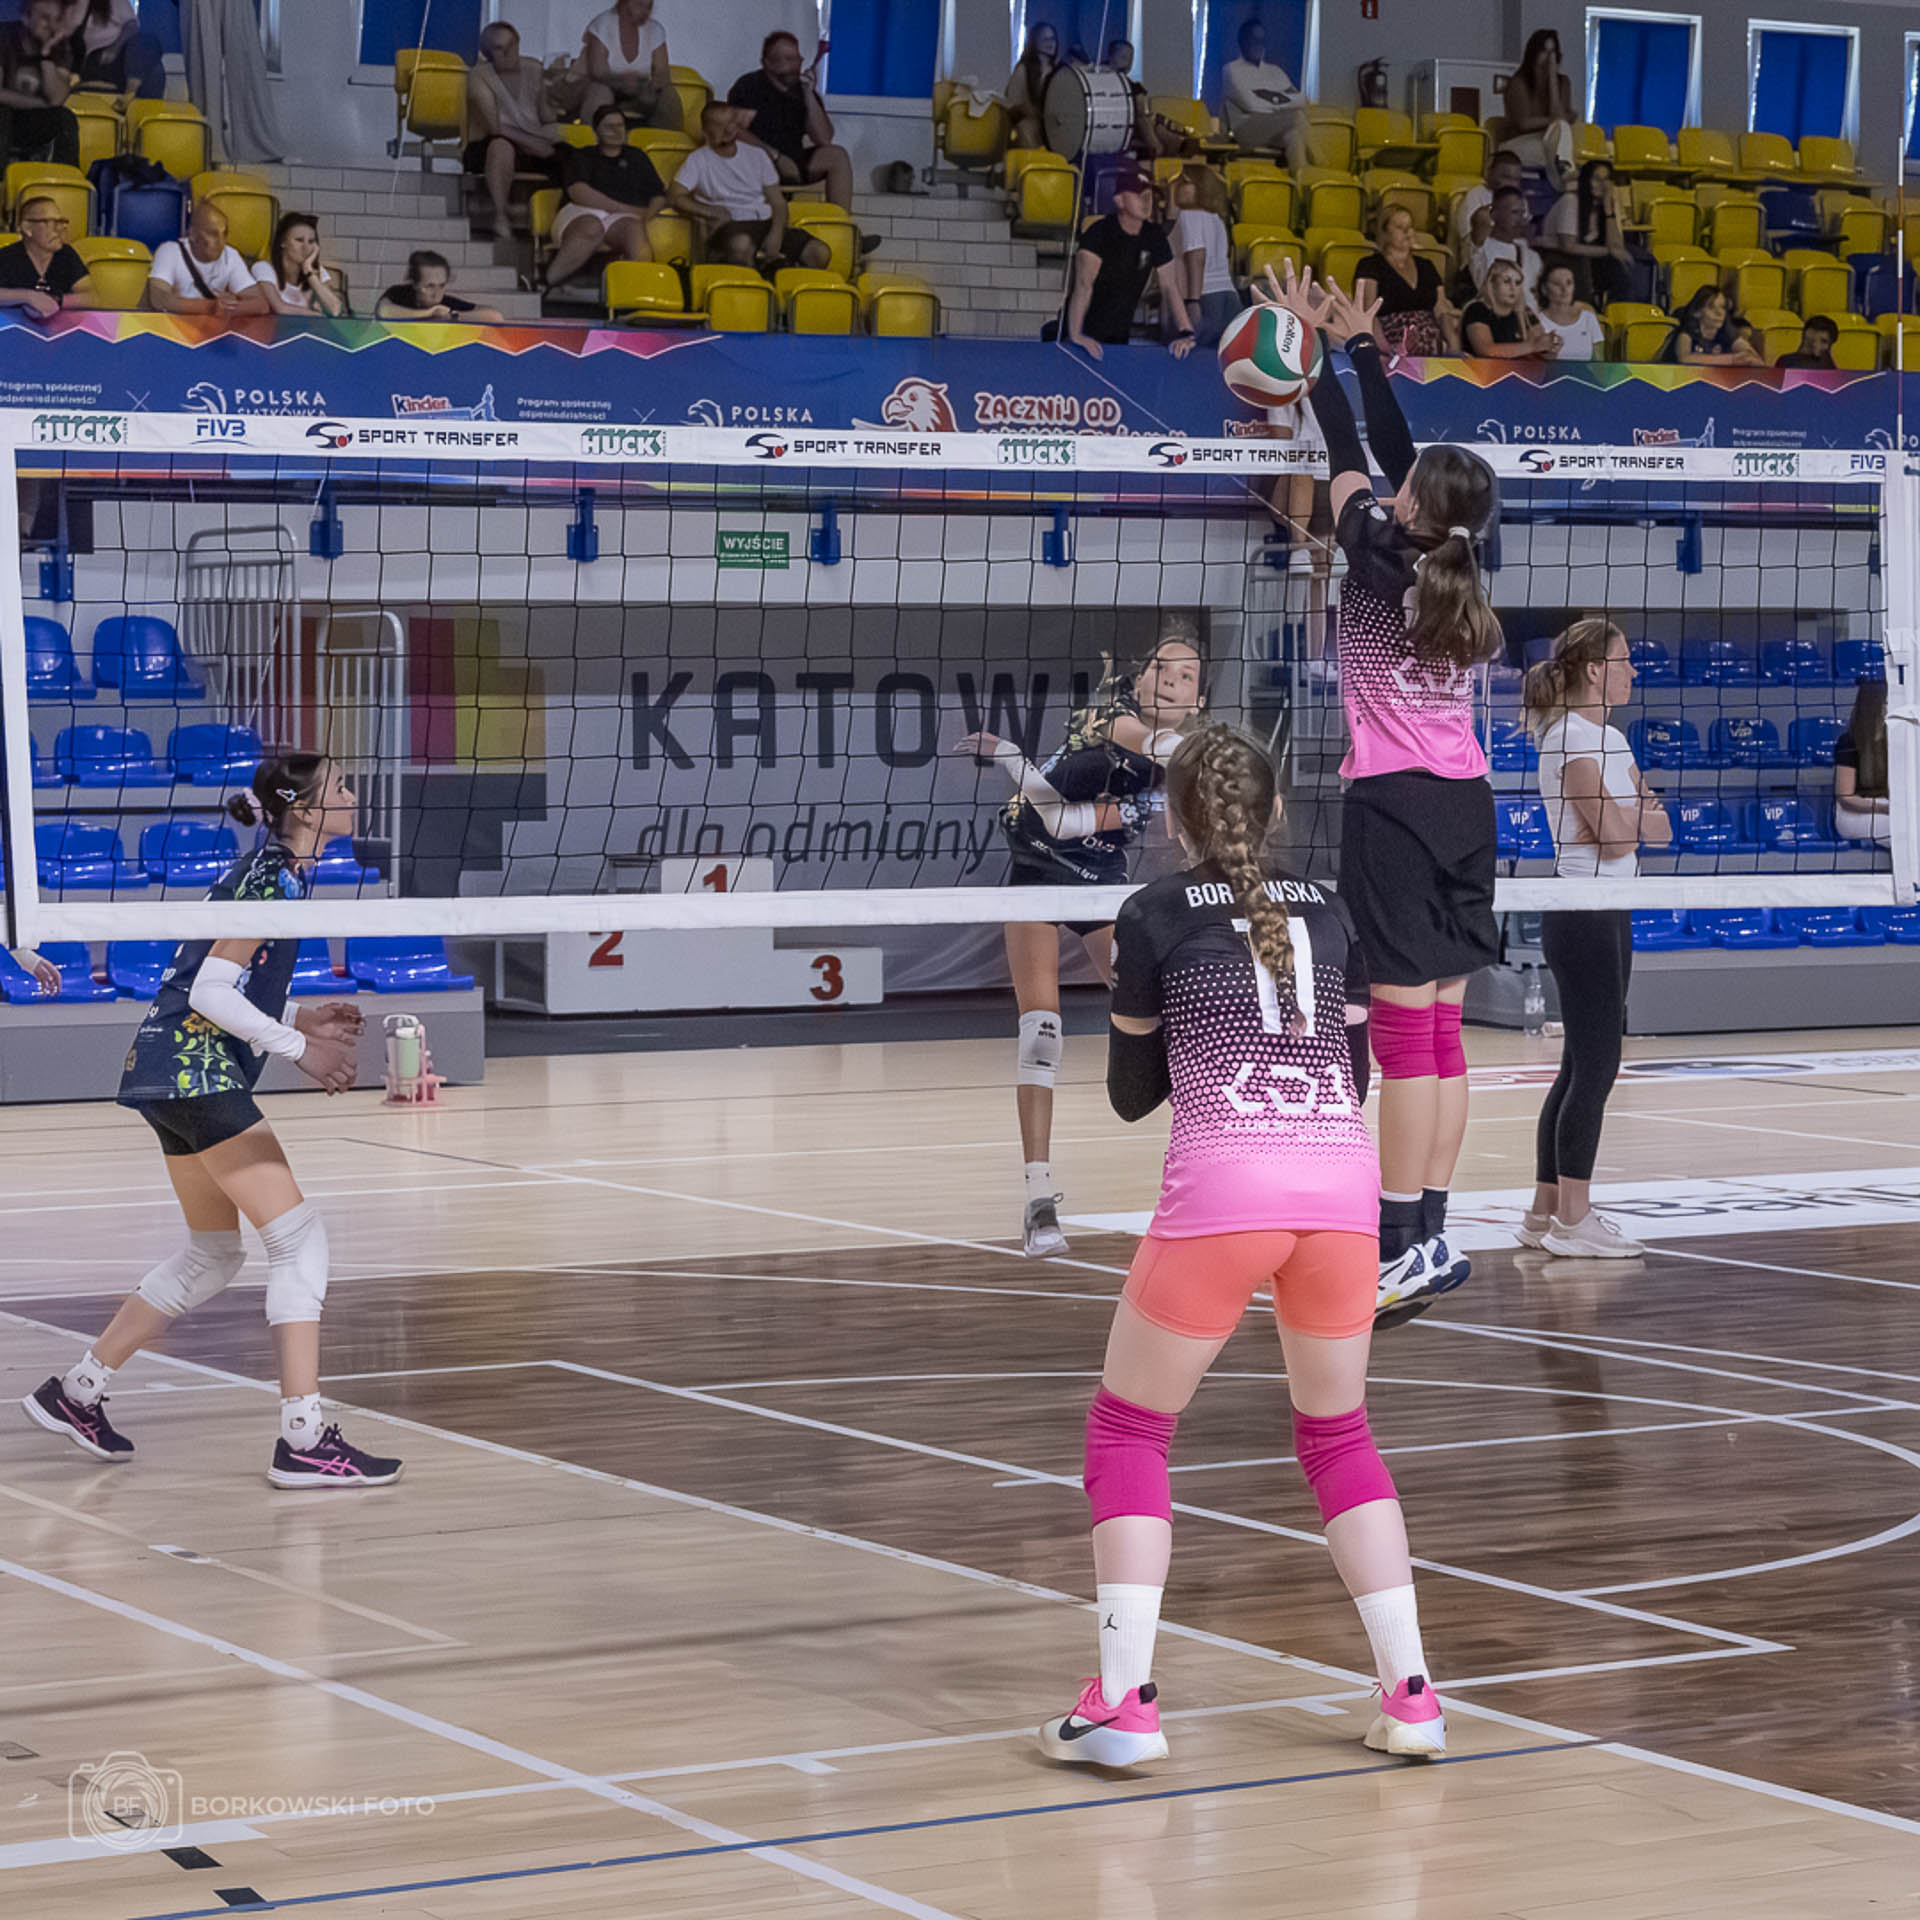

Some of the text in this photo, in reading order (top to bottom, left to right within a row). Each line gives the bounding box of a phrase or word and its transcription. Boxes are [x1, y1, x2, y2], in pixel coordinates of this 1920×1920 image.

[1282, 314, 1296, 353] molten
[235, 389, 326, 406] POLSKA
[731, 406, 813, 423] POLSKA
[1085, 399, 1120, 424] OD
[32, 414, 122, 444] HUCK
[197, 418, 246, 436] FIVB
[1513, 426, 1581, 440] POLSKA
[359, 430, 518, 446] SPORT TRANSFER
[581, 428, 662, 457] HUCK
[794, 440, 942, 456] SPORT TRANSFER
[997, 438, 1072, 465] HUCK
[1192, 449, 1327, 463] SPORT TRANSFER
[1559, 456, 1684, 469] SPORT TRANSFER
[1732, 453, 1796, 477] HUCK
[1851, 454, 1886, 469] FIVB
[723, 534, 785, 550] WYJŚCIE
[1509, 811, 1529, 825] VIP
[1681, 808, 1700, 821] VIP
[1765, 808, 1785, 820] VIP
[748, 805, 994, 875] odmiany
[703, 864, 727, 892] 1
[1185, 881, 1326, 907] BORWSKA
[588, 931, 624, 967] 2
[810, 955, 844, 1000] 3
